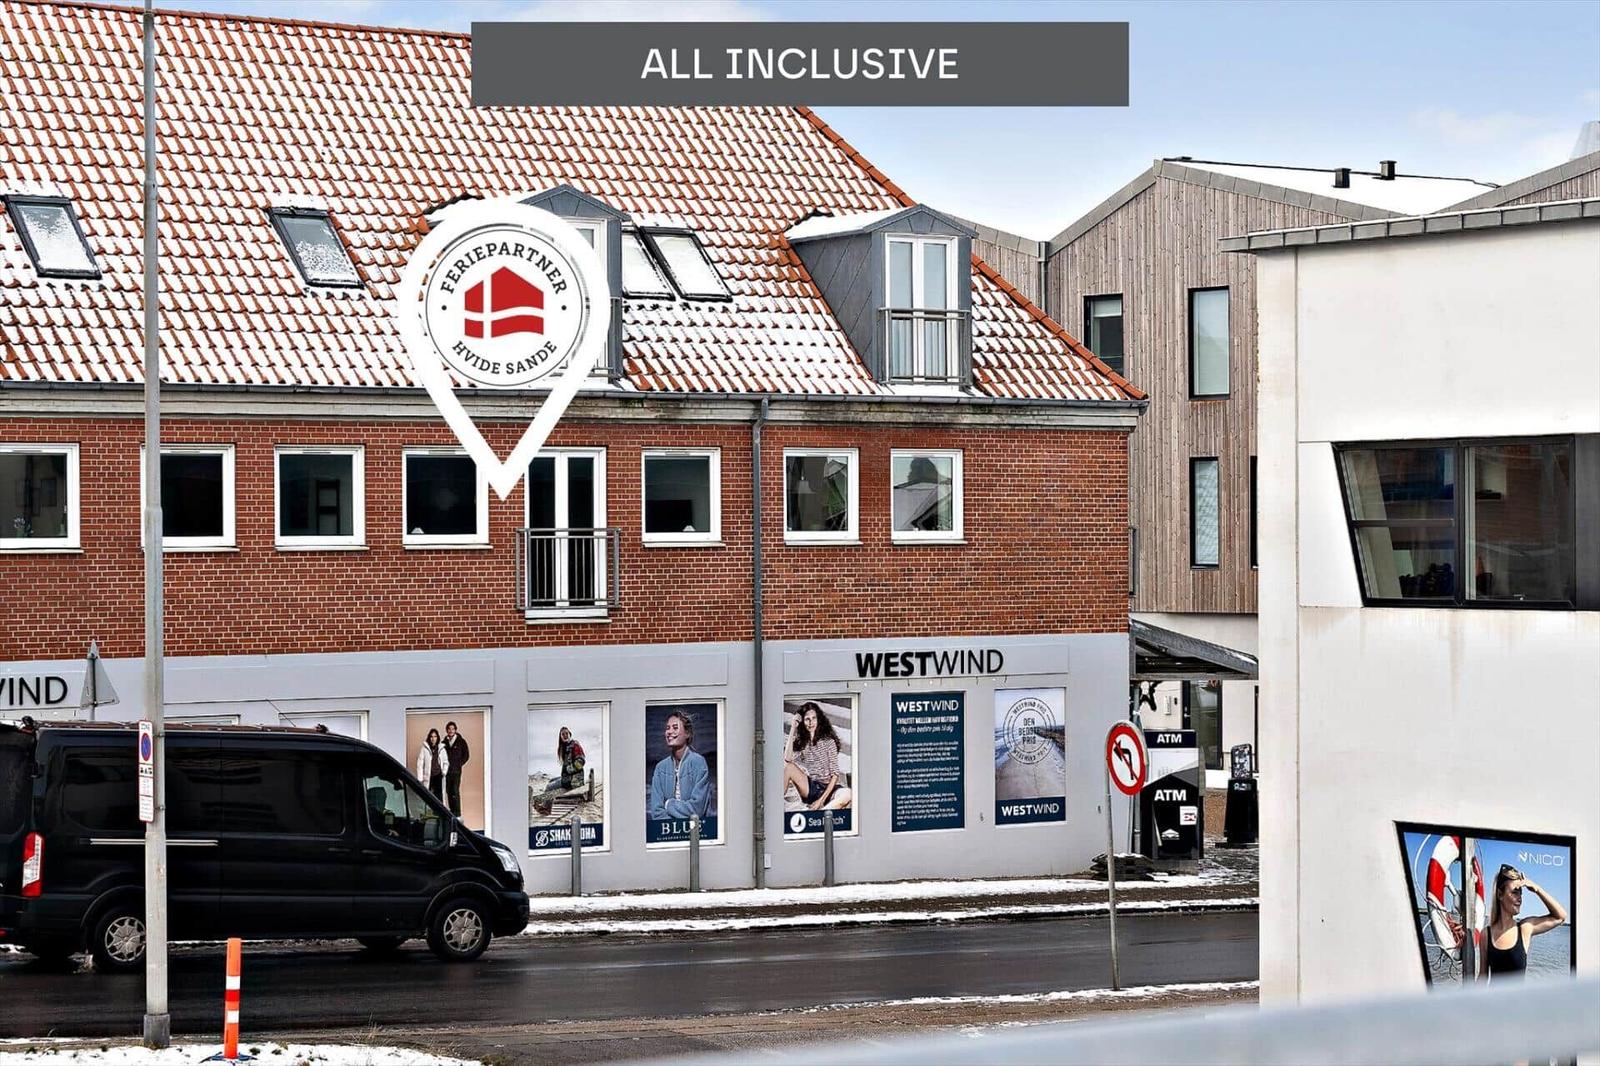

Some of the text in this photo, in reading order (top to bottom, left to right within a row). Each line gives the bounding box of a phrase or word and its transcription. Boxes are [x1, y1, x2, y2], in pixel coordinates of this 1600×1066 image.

[856, 649, 1004, 677] WESTWIND
[0, 676, 68, 706] IND
[896, 700, 959, 712] WESTWIND
[1157, 734, 1182, 743] ATM
[1154, 790, 1186, 801] ATM
[1001, 803, 1060, 816] WESTWIND
[808, 817, 822, 827] Sea
[549, 827, 596, 842] SHAKOHA
[1528, 853, 1563, 865] NICO
